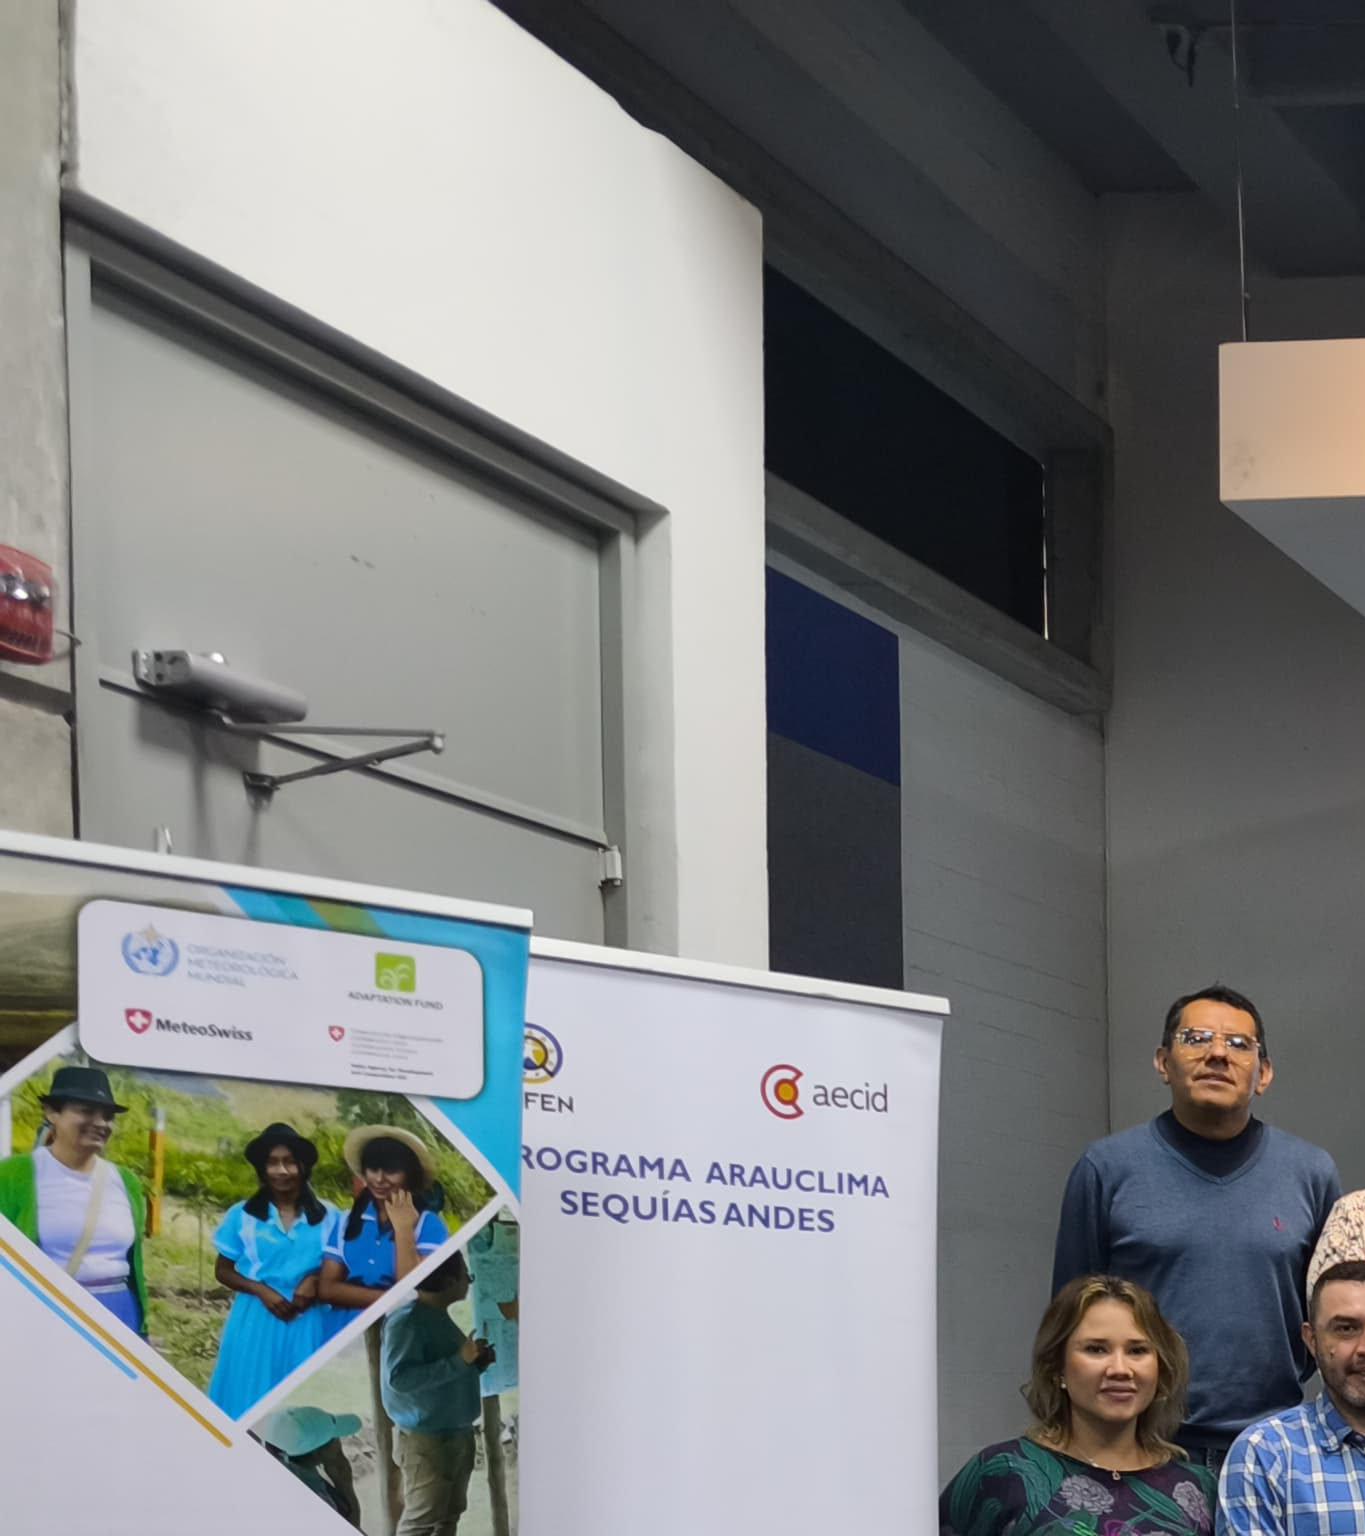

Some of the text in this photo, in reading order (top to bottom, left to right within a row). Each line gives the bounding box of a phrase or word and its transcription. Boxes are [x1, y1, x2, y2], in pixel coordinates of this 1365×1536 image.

[348, 991, 443, 1010] ADAPTATION FUND
[155, 1018, 253, 1041] MeteoSwiss
[524, 1091, 574, 1113] FEN
[812, 1083, 888, 1113] aecid
[521, 1144, 889, 1198] ROGRAMA ARAUCLIMA
[560, 1181, 836, 1233] SEQUÍAS ANDES
